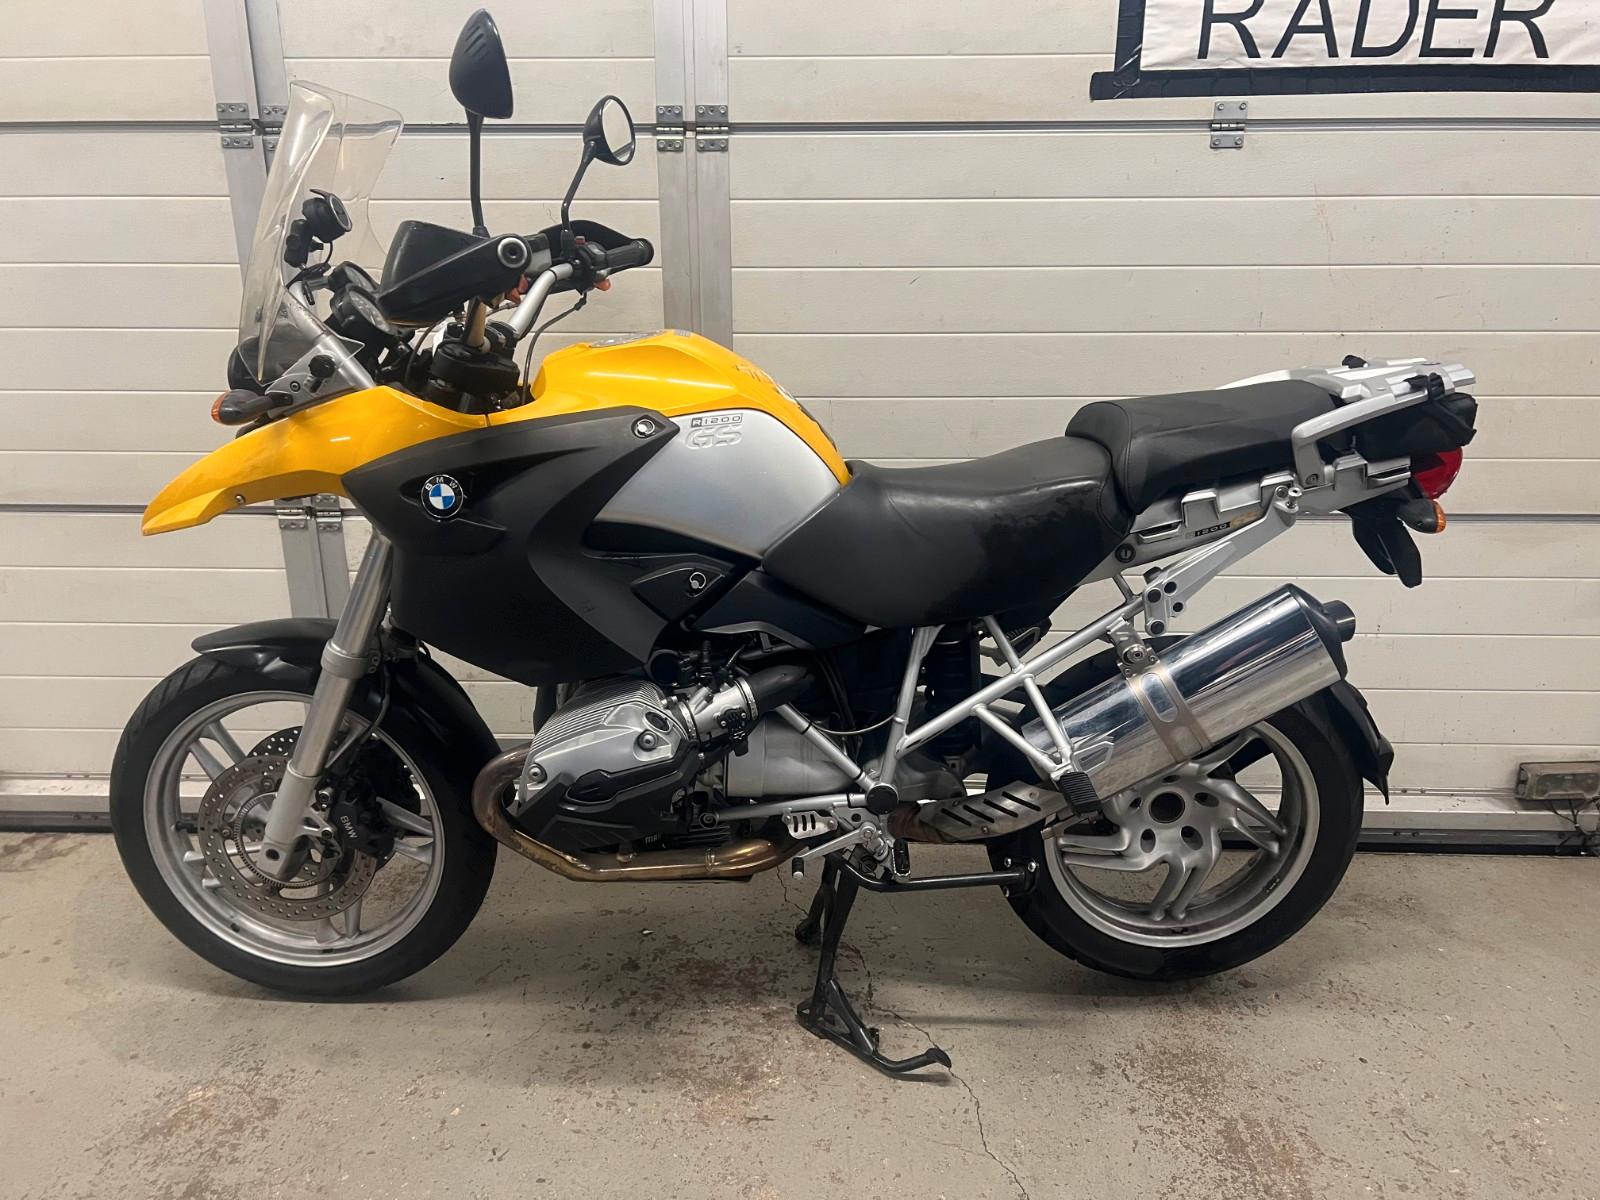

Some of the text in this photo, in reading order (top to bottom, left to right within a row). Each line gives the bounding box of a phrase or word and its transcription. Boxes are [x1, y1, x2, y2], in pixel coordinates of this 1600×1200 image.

[1196, 0, 1556, 59] RADER
[685, 424, 743, 450] GS
[425, 476, 458, 491] BMW
[340, 815, 358, 839] BMW
